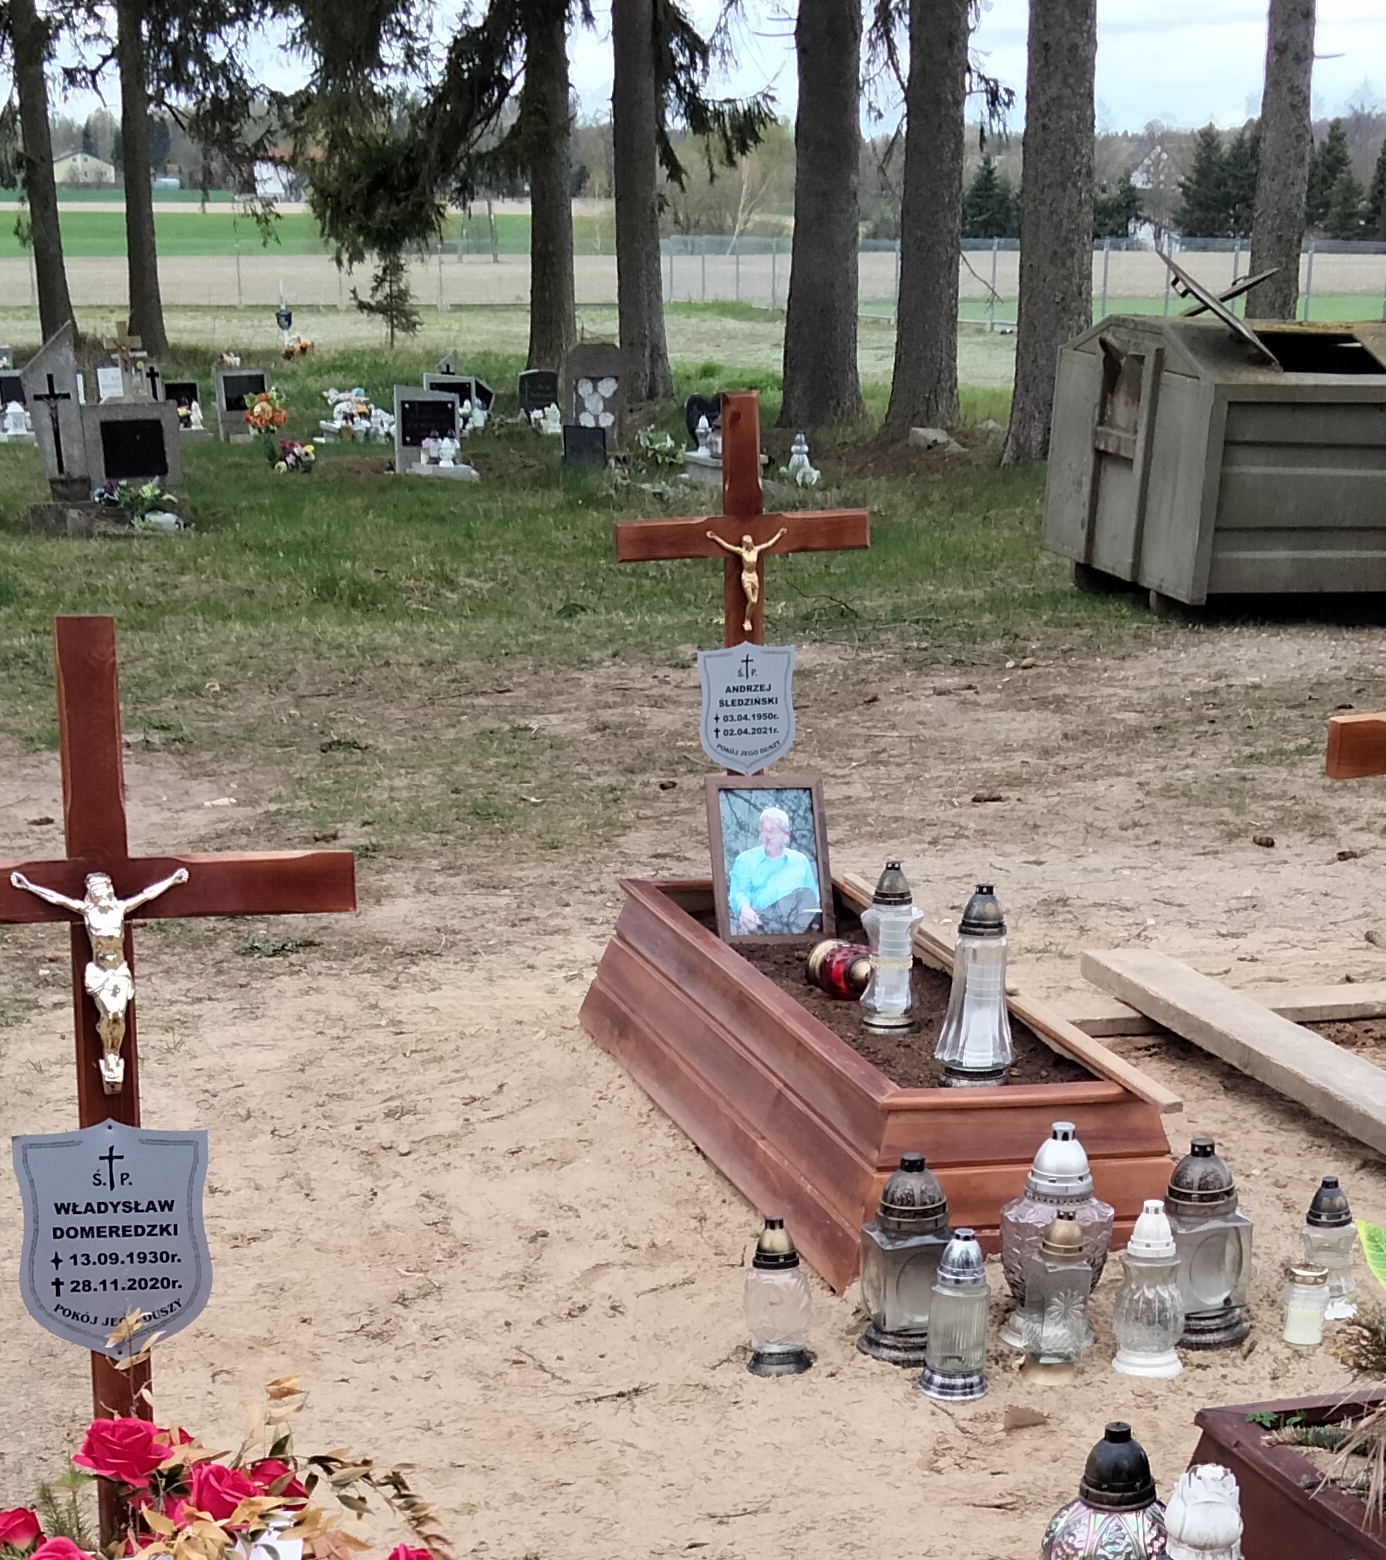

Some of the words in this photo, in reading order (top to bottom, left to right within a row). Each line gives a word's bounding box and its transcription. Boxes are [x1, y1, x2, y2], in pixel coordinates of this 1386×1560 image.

[725, 684, 772, 694] ANDRZEJ
[718, 696, 779, 708] ŚLEDZIŃSKI
[723, 712, 779, 723] 03.04.1950r.
[723, 727, 779, 737] 02.04.2021r.
[716, 743, 739, 756] POKÓJ
[740, 748, 759, 756] JEGO
[759, 740, 781, 754] DUSZY
[54, 1200, 175, 1215] WŁADYSŁAW
[52, 1224, 179, 1239] DOMEREDZKI
[69, 1250, 182, 1266] 13.09.1930r.
[70, 1277, 183, 1293] 28.11.2020r.
[53, 1303, 98, 1326] POKÓJ
[142, 1298, 183, 1322] DUSZY
